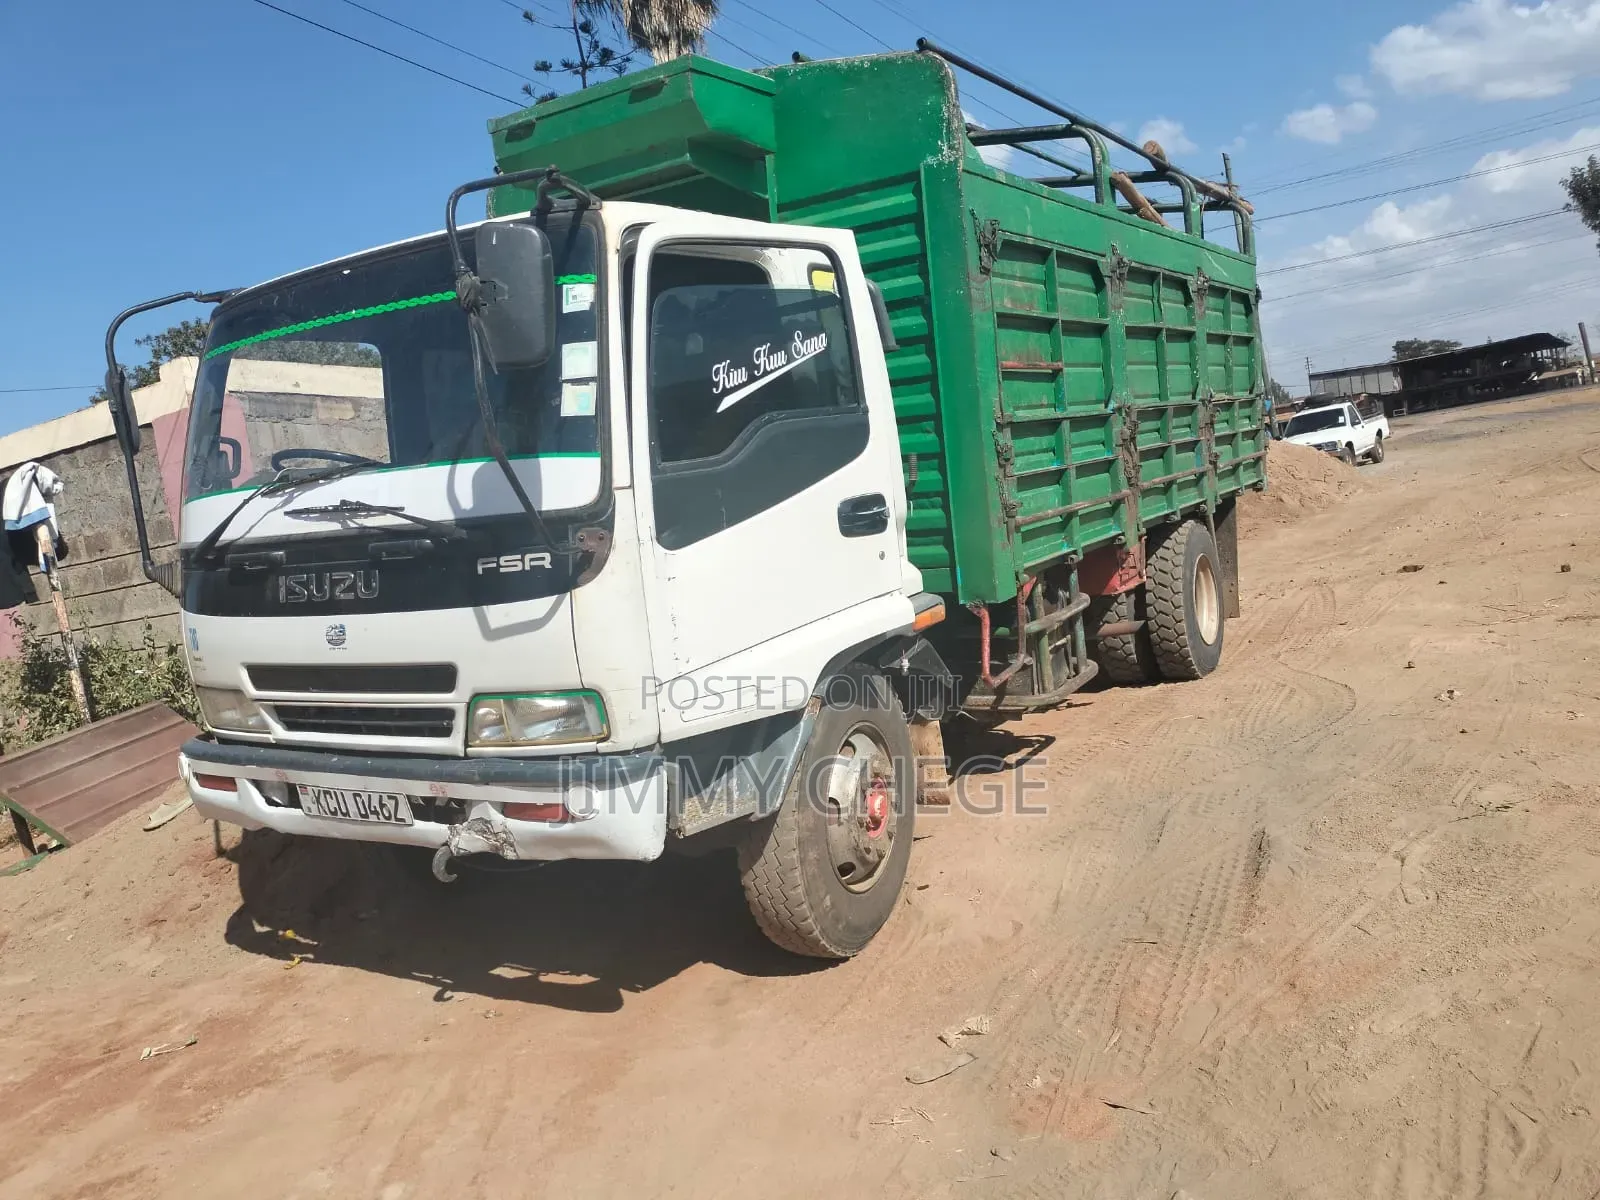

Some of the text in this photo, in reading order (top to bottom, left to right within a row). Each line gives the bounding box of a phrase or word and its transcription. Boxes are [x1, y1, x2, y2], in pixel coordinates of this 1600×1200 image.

[792, 330, 828, 359] Sana
[477, 552, 552, 575] FSR
[278, 569, 379, 604] ISUZU
[312, 787, 351, 818] KCU
